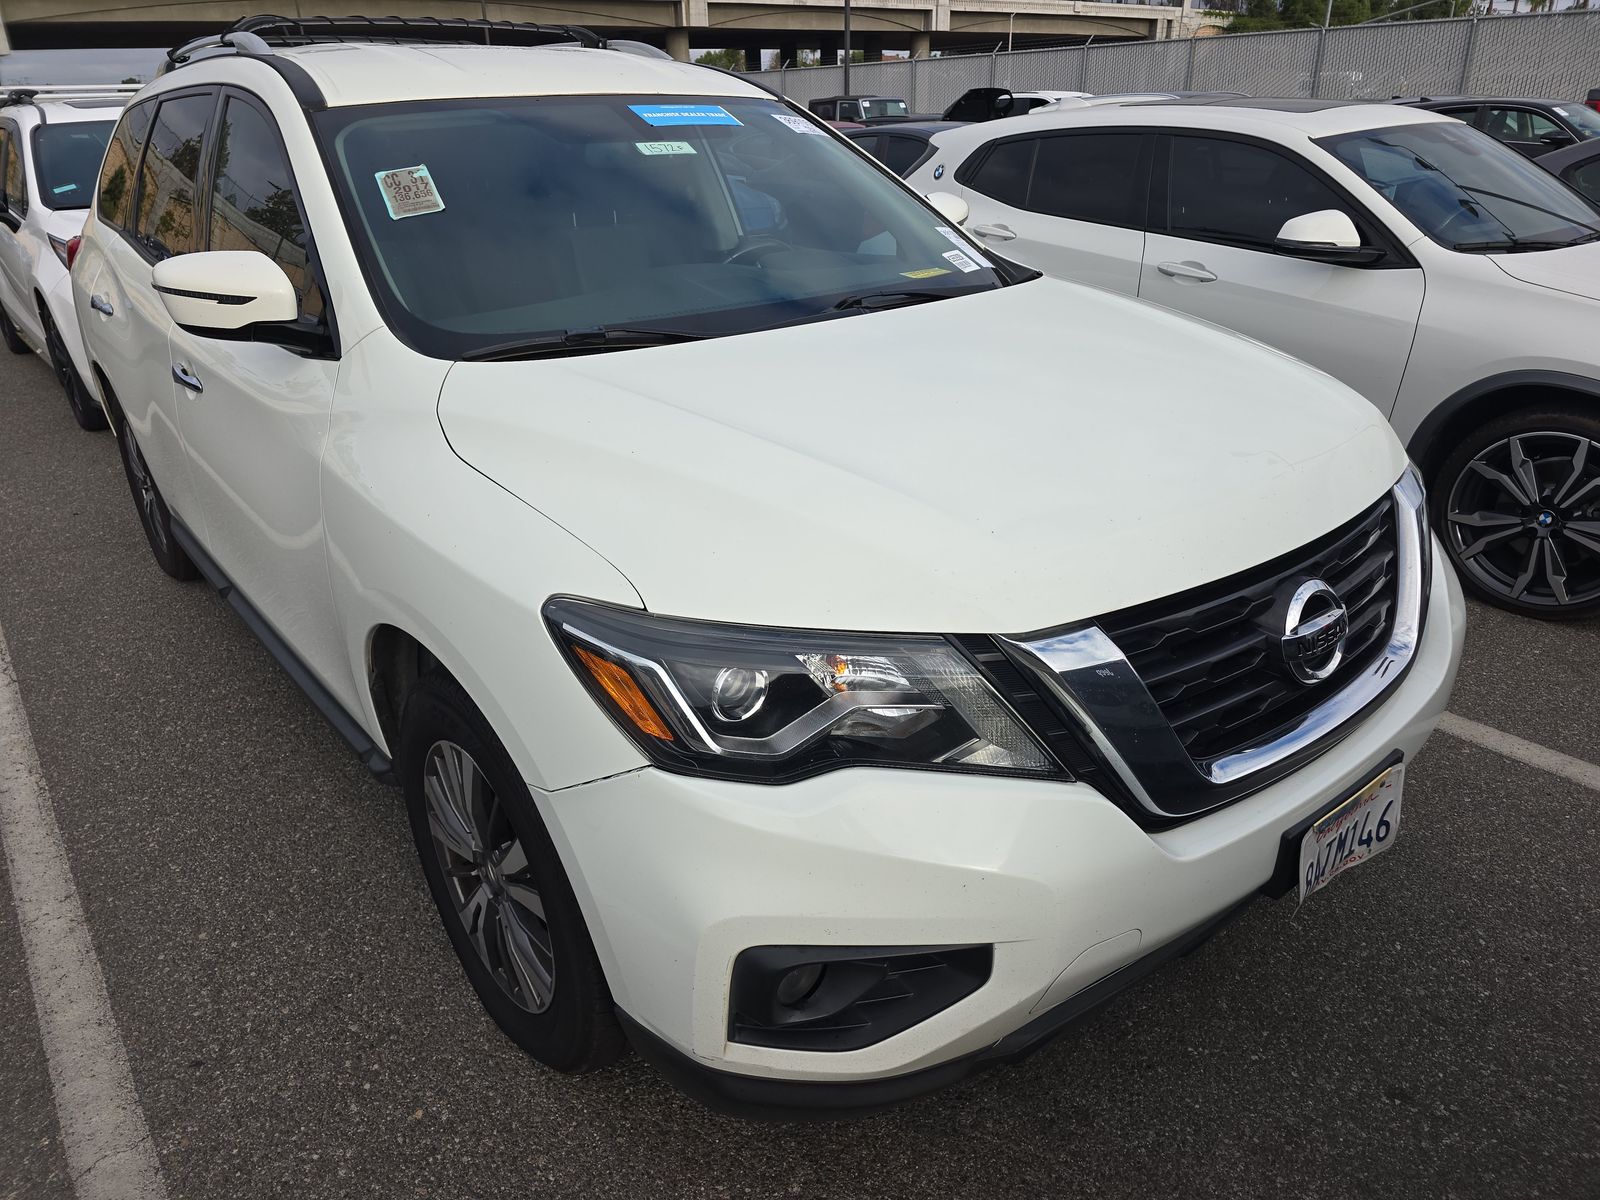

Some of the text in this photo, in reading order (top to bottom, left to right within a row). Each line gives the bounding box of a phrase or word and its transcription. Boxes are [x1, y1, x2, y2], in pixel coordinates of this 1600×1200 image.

[383, 173, 401, 188] CC
[393, 182, 429, 195] 2017
[1297, 620, 1346, 657] NISSAN
